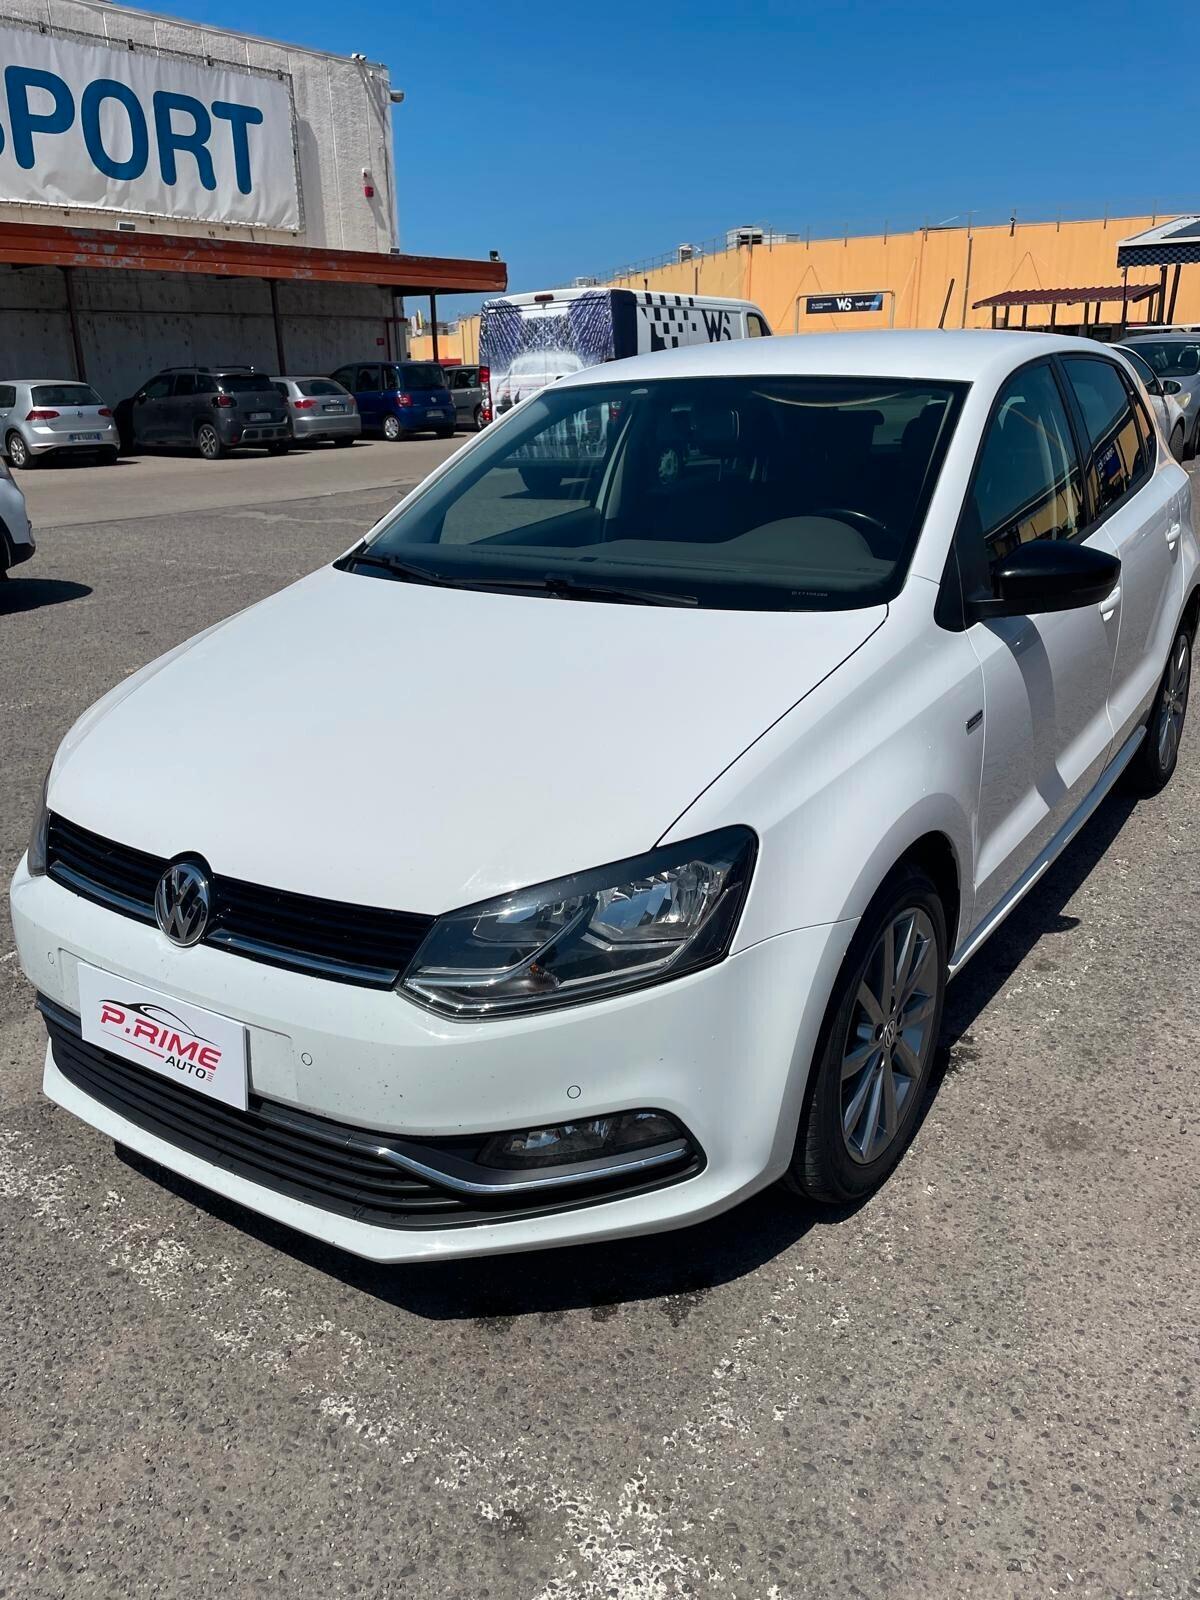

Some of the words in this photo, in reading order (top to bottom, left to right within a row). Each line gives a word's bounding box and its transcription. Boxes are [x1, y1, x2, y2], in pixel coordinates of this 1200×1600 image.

[0, 65, 264, 195] PORT
[836, 298, 852, 311] WS
[100, 1004, 222, 1071] P.RIME
[165, 1055, 207, 1079] AUTO
